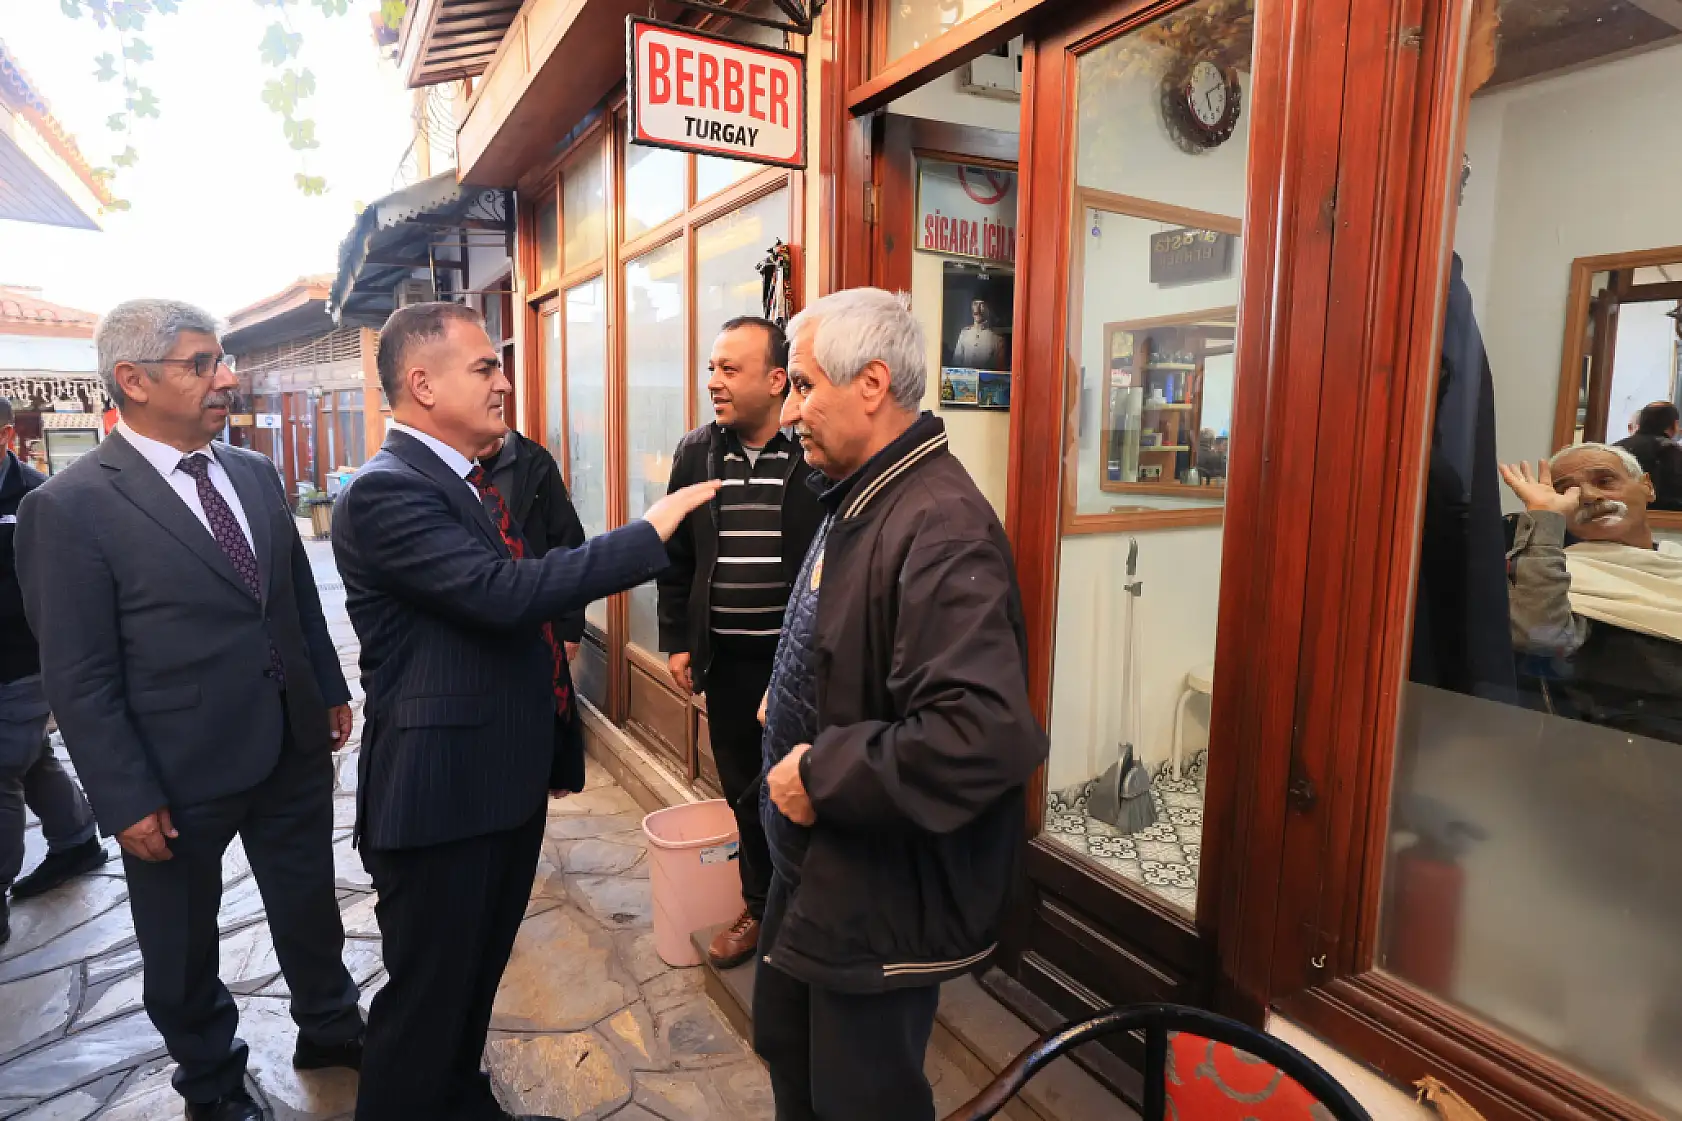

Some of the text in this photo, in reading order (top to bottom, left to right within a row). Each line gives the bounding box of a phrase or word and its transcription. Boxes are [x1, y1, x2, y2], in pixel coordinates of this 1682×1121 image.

[648, 41, 789, 129] BERBER
[684, 115, 759, 147] TURGAY
[924, 208, 979, 257] SİGARA
